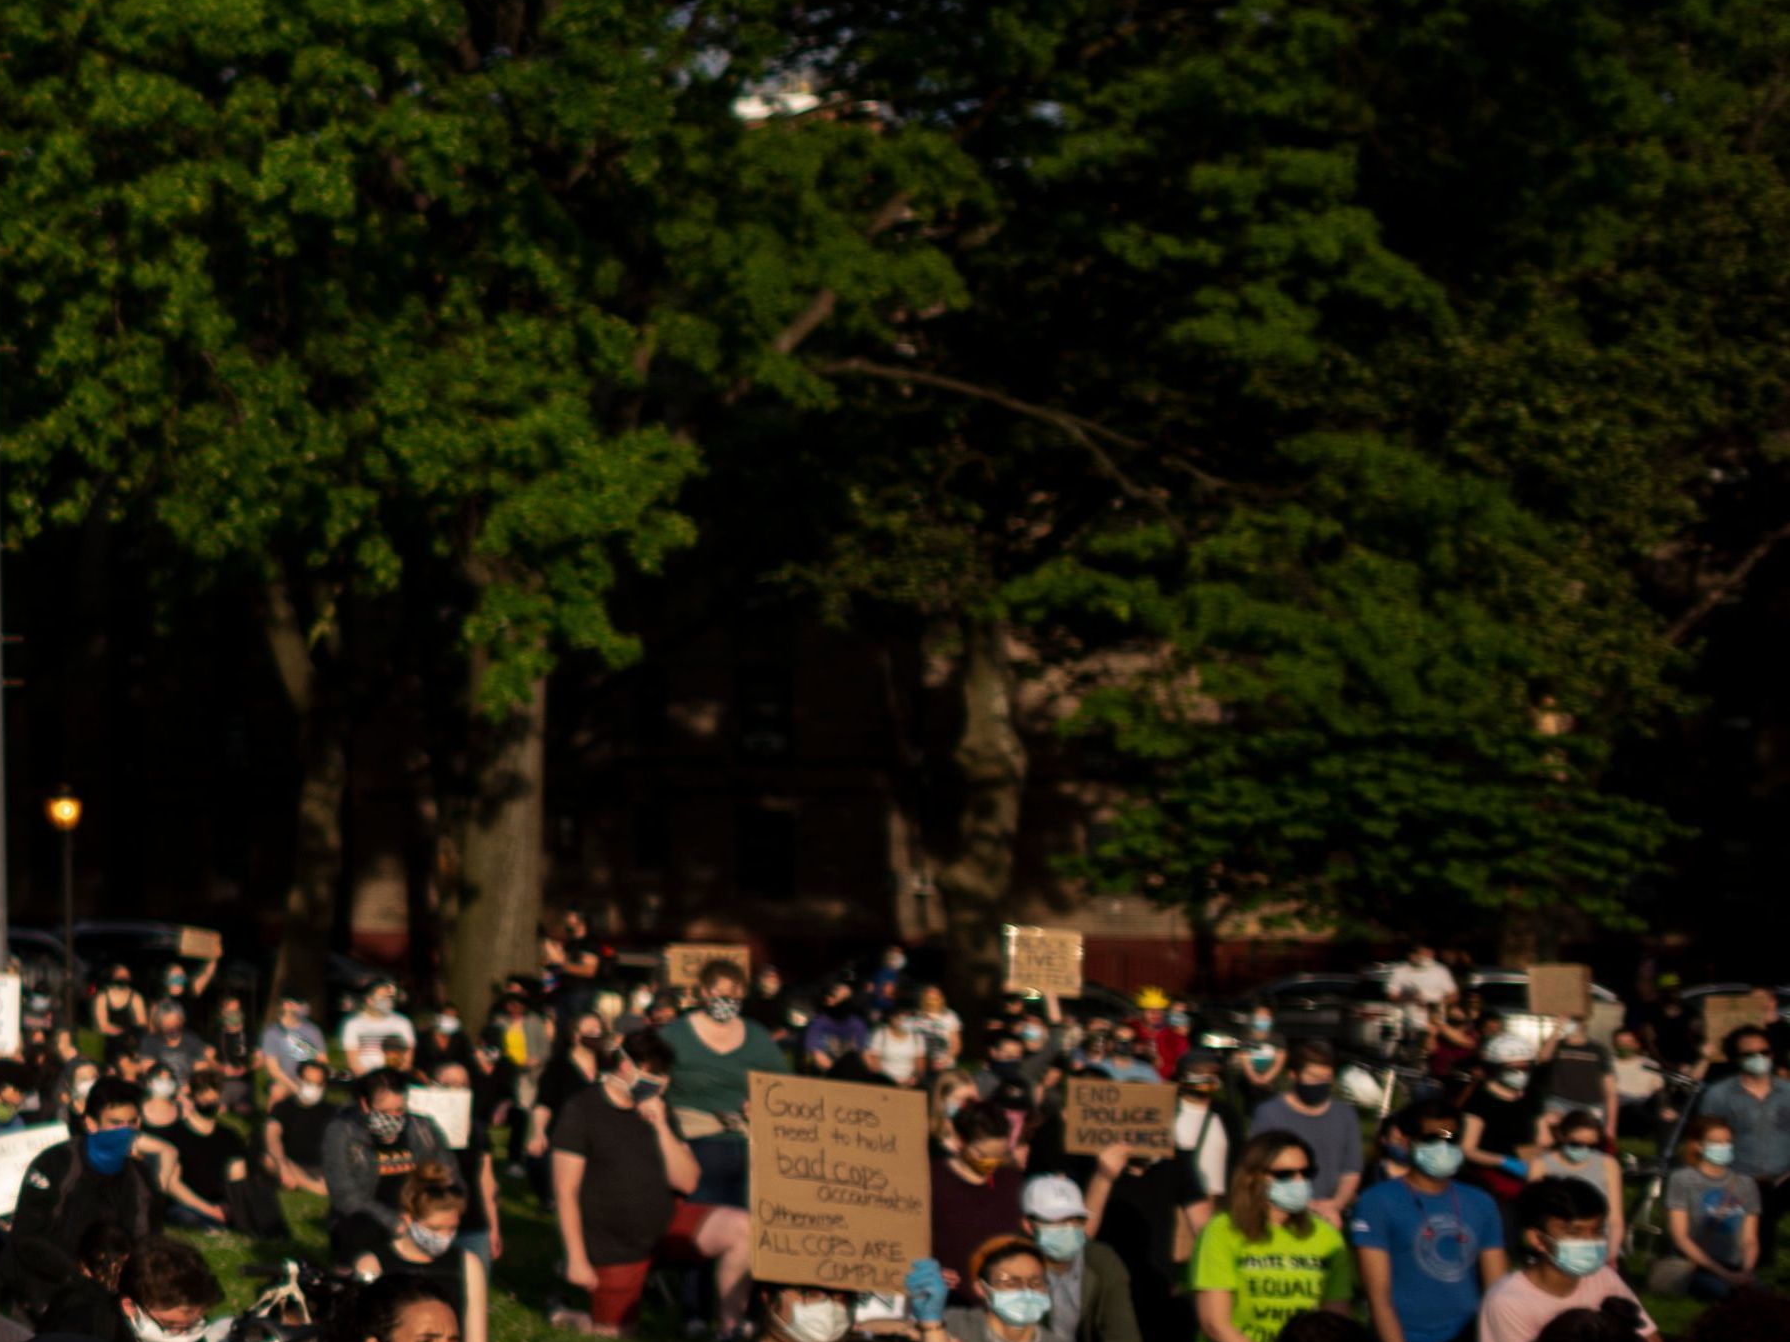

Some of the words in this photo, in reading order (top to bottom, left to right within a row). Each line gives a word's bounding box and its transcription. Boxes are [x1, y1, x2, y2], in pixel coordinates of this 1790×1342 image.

[764, 1081, 825, 1123] Good
[833, 1106, 881, 1129] cops
[1075, 1084, 1121, 1105] END
[1081, 1106, 1161, 1125] POLICE
[773, 1123, 819, 1143] need
[830, 1128, 850, 1146] to
[856, 1131, 898, 1154] hold
[775, 1147, 827, 1181] bad
[832, 1160, 890, 1191] cops
[758, 1229, 800, 1256] ALL
[800, 1233, 857, 1258] COPS
[861, 1239, 907, 1264] ARE
